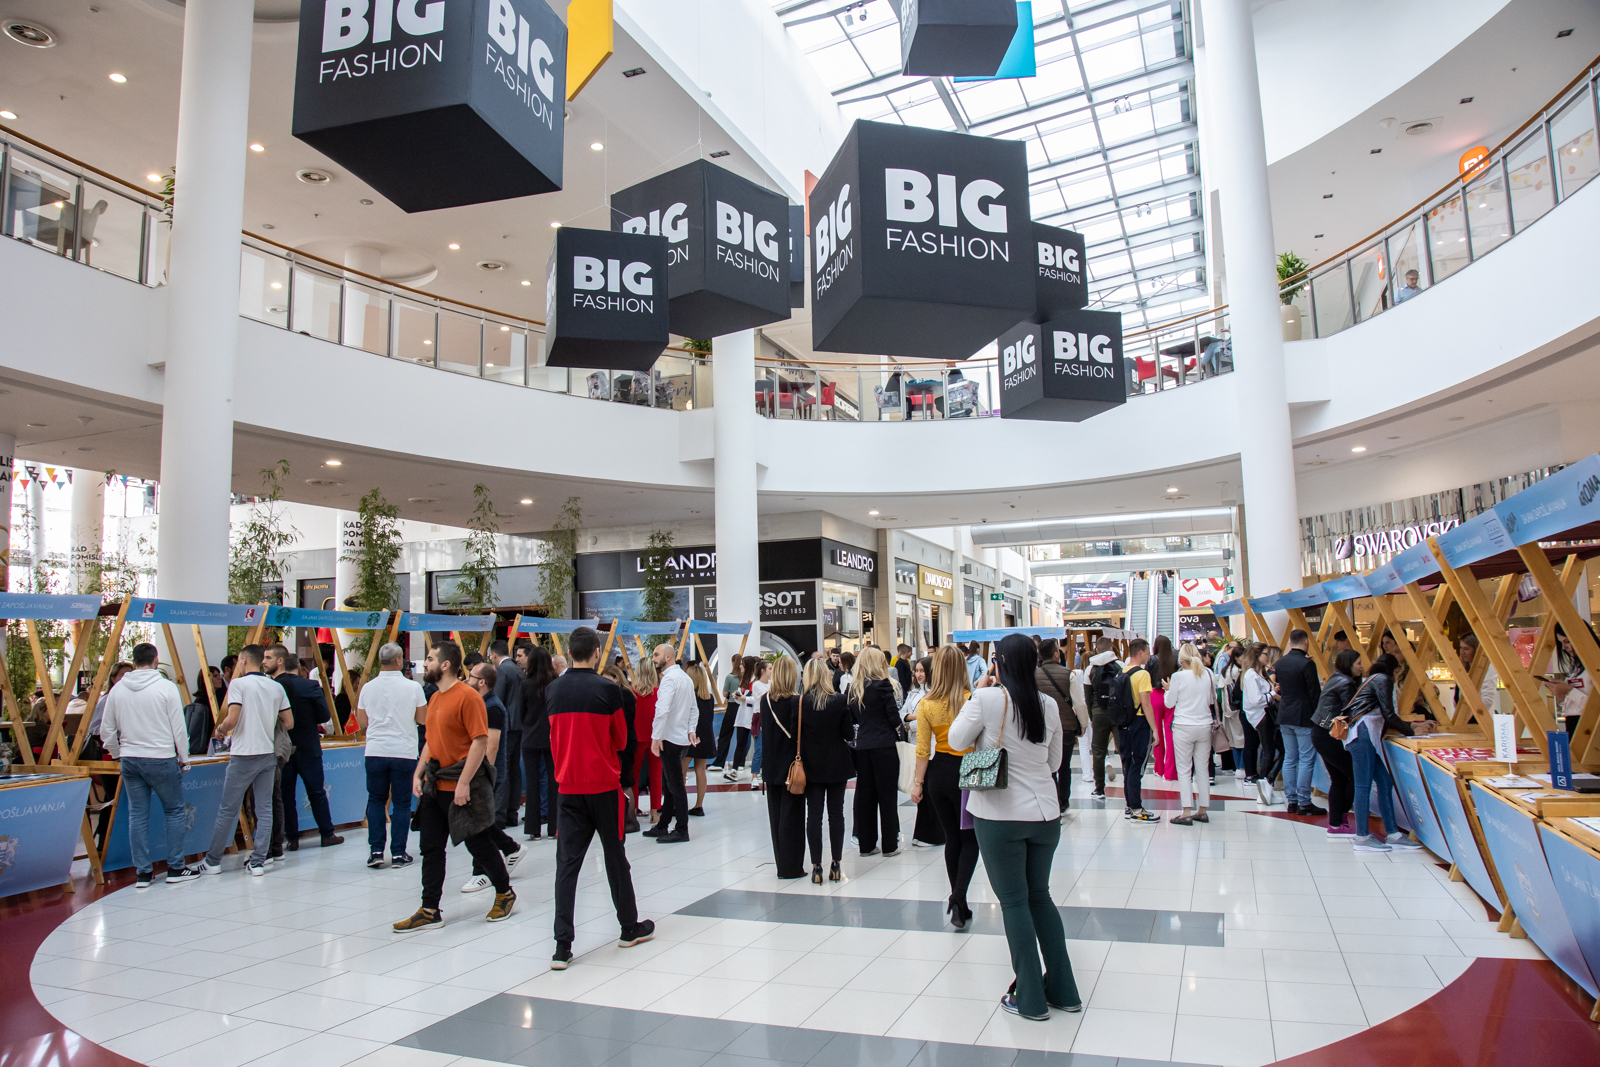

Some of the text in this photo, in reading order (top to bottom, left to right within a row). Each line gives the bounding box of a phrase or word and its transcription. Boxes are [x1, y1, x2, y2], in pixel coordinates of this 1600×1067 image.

[322, 0, 445, 53] BIG
[319, 39, 443, 83] FASHION
[488, 0, 554, 103] BIG
[486, 42, 553, 131] FASHION
[885, 167, 1008, 233] BIG
[716, 200, 779, 262] BIG
[816, 183, 851, 274] BIG
[886, 228, 1009, 262] FASHION
[716, 245, 779, 282] FASHION
[816, 238, 853, 300] FASHION
[1038, 242, 1080, 272] BIG
[1038, 267, 1081, 284] FASHION
[573, 256, 653, 296] BIG
[573, 293, 654, 314] FASHION
[1003, 334, 1036, 376] BIG
[1053, 331, 1113, 364] BIG
[1004, 364, 1037, 390] FASHION
[1054, 362, 1114, 379] FASHION
[836, 549, 874, 572] LEANDRO
[1, 601, 54, 610] ZAPOŠLJAVANJA
[1500, 722, 1509, 758] KARISMA
